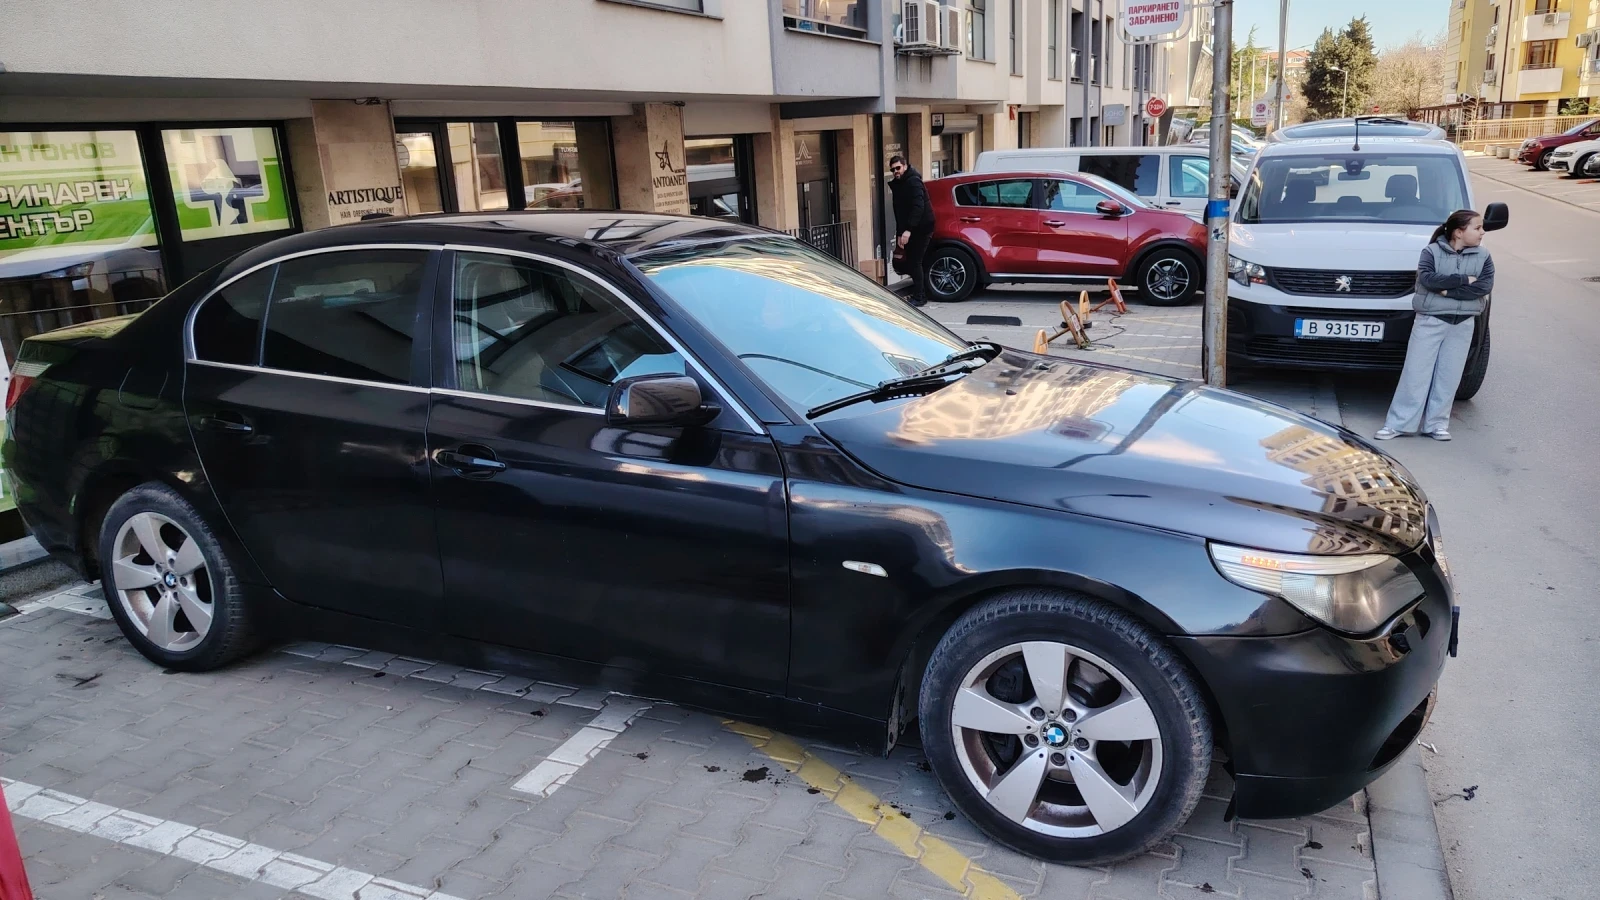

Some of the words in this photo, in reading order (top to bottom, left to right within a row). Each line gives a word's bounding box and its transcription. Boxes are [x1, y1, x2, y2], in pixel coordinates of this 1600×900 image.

[1128, 1, 1179, 14] ПАРКИРАНЕТО
[1129, 12, 1178, 26] ЗАБРАНЕНО!
[0, 142, 117, 163] НТОНОВ
[653, 174, 686, 188] ANTOANET
[328, 186, 403, 206] ARTISTIQUE
[1309, 322, 1318, 334] B
[1326, 323, 1359, 336] 9315
[1363, 324, 1381, 337] TP
